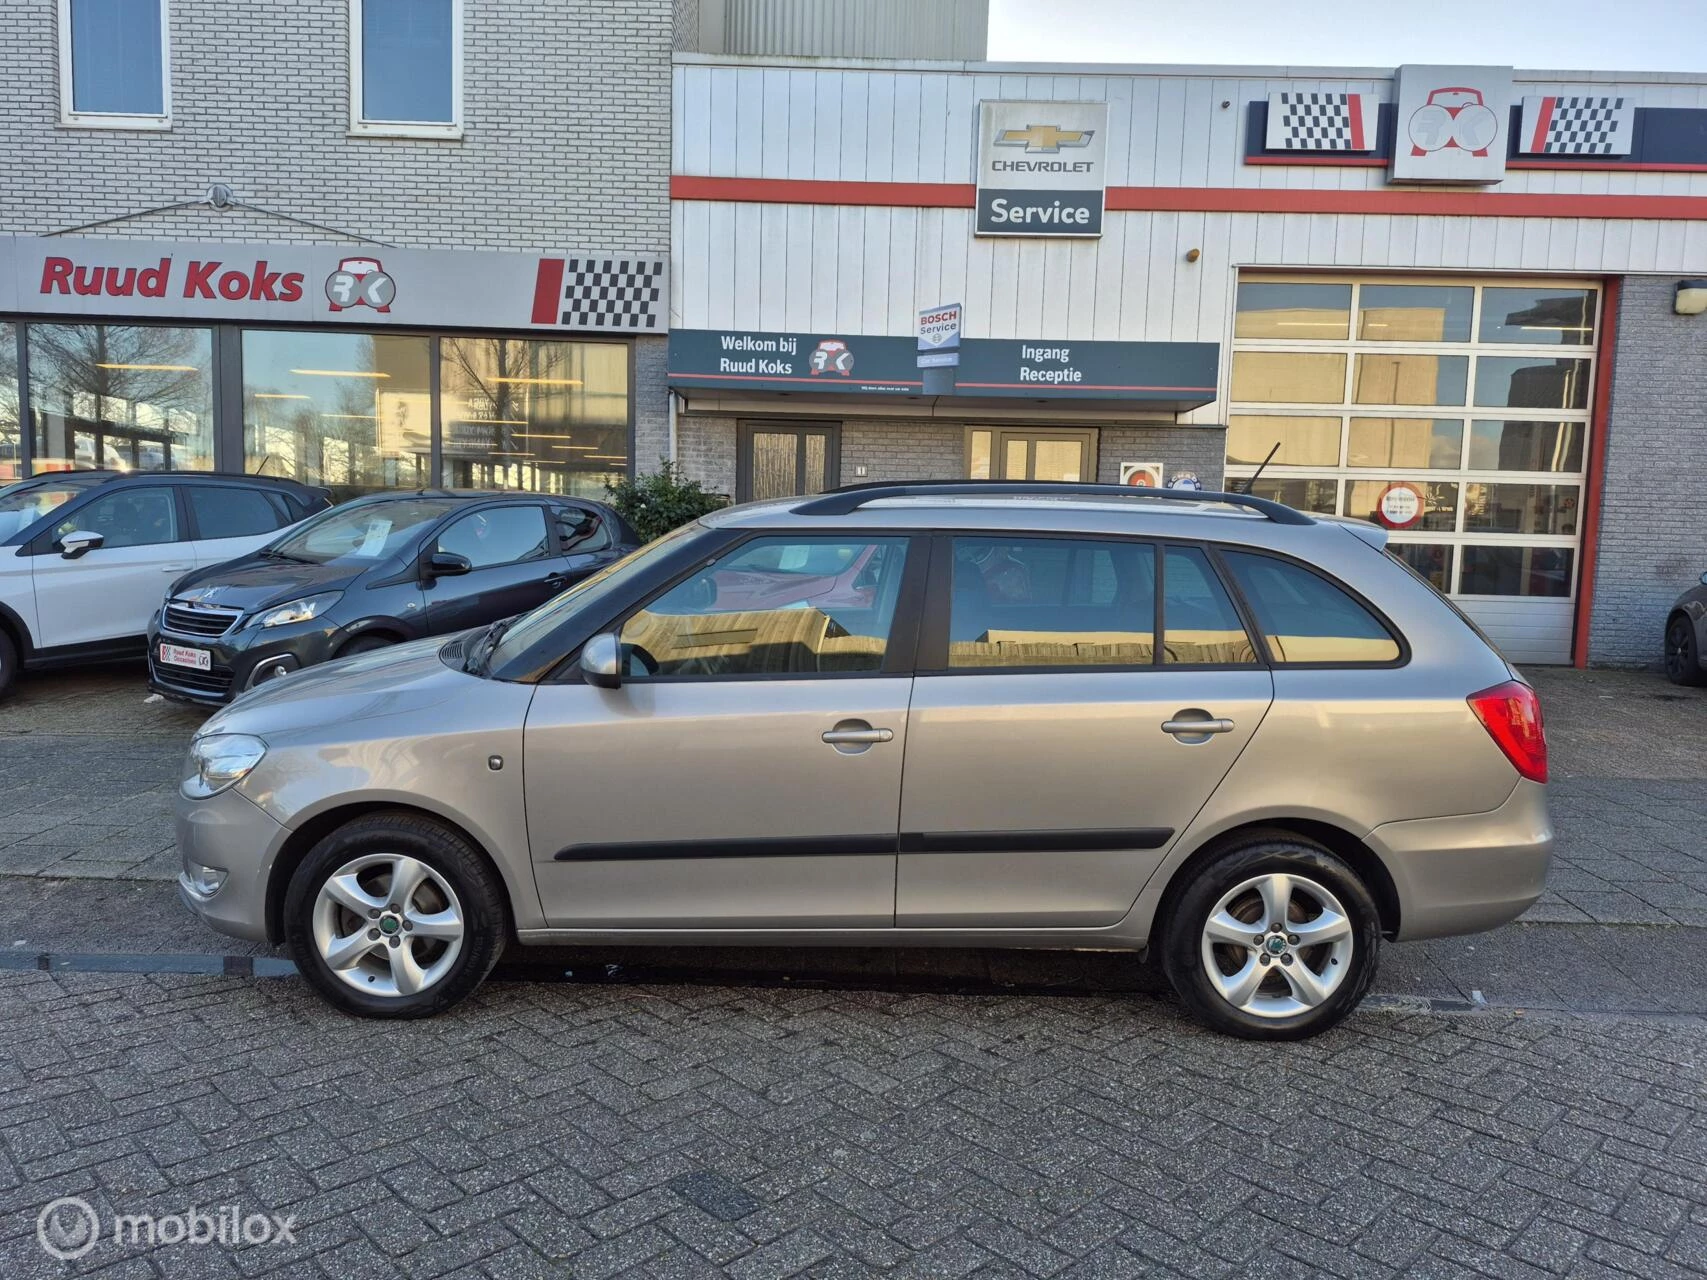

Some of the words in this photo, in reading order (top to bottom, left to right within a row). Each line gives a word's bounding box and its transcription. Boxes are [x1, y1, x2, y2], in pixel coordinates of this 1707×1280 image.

[992, 160, 1094, 172] CHEVROLET
[990, 198, 1090, 224] Service
[40, 256, 172, 298] Ruud
[182, 260, 305, 302] Koks
[920, 310, 957, 325] BOSCH
[920, 322, 957, 335] Service
[721, 336, 776, 352] Welkom
[779, 337, 797, 356] bij
[1022, 344, 1070, 363] Ingang
[720, 357, 756, 373] Ruud
[759, 359, 793, 375] Koks
[1020, 366, 1082, 385] Receptie
